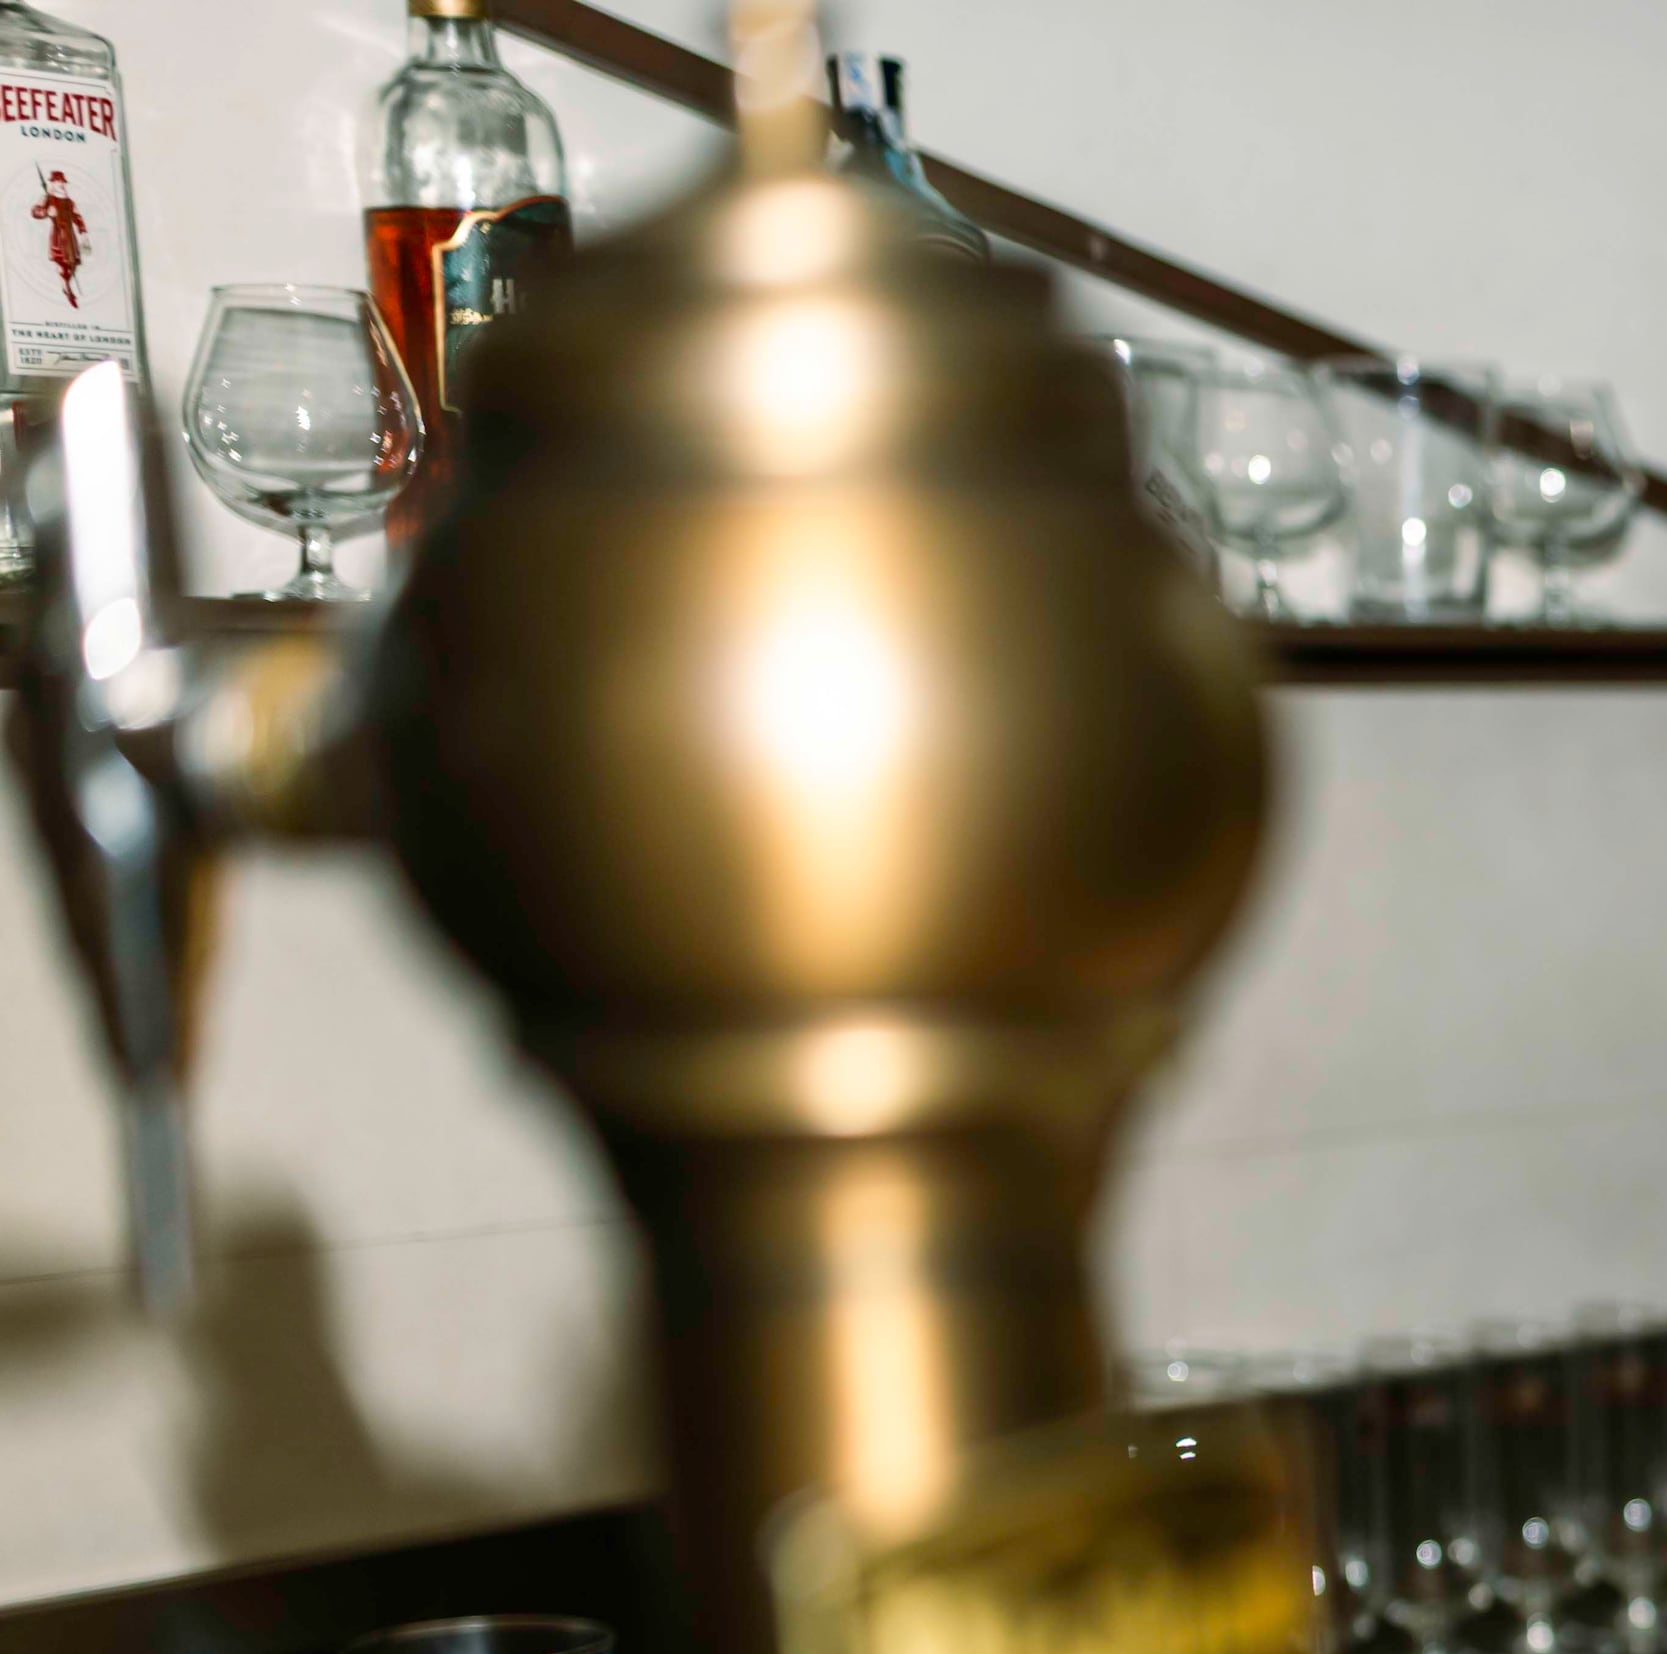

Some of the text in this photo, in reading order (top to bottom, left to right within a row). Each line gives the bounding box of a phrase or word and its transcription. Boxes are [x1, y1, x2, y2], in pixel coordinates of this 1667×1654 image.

[0, 84, 117, 142] EEFEATER
[20, 125, 86, 142] LONDON
[11, 328, 33, 338] THE
[36, 330, 70, 340] HEART
[89, 335, 131, 345] LONDON
